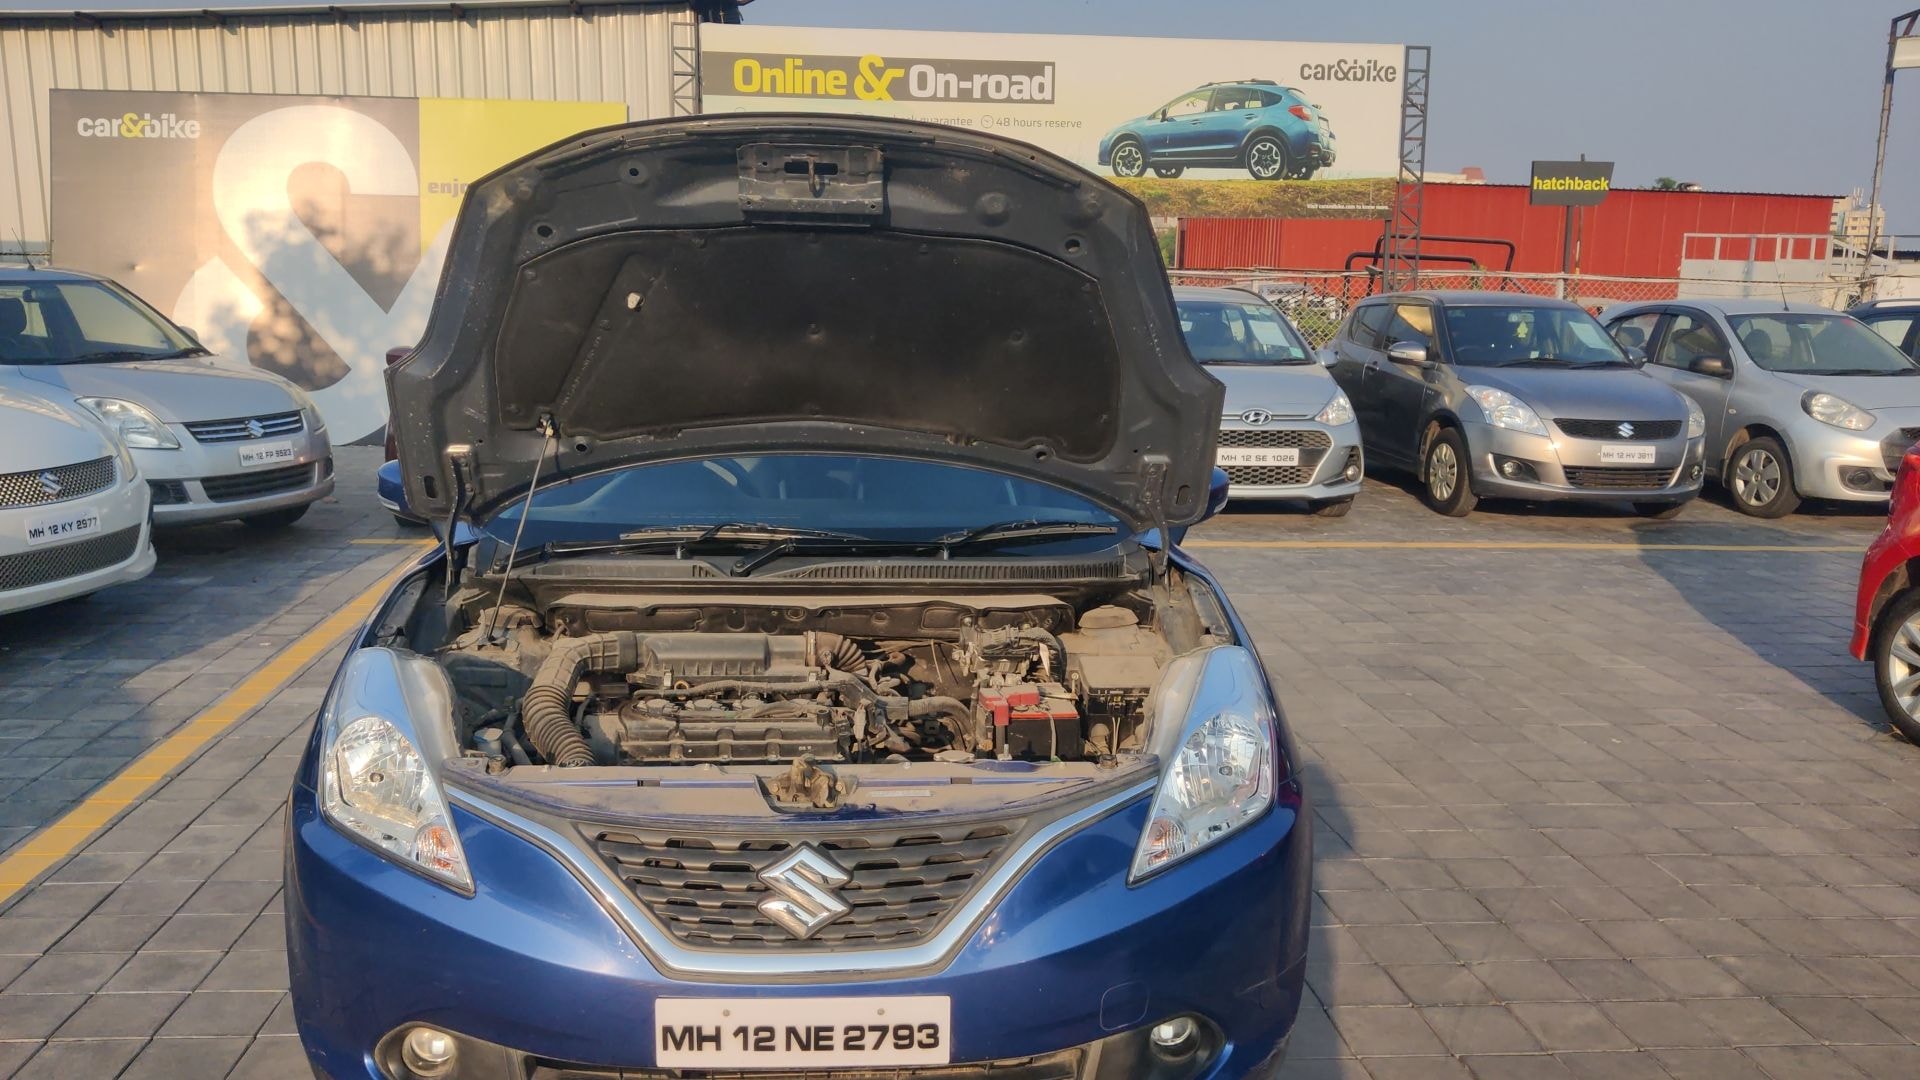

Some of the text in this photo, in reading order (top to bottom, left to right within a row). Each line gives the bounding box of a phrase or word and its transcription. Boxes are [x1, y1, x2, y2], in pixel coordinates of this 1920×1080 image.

[733, 53, 1053, 101] Online & On-road
[1300, 58, 1397, 82] car&bike
[77, 112, 201, 139] car&bike
[919, 116, 973, 127] uarantee
[996, 117, 1011, 127] 48
[1013, 118, 1042, 128] hours
[1044, 119, 1083, 129] reserve
[1533, 175, 1610, 191] hatchback
[1221, 454, 1295, 462] MH 12 SE 1026
[1602, 451, 1614, 459] MH
[29, 517, 97, 538] MH 12 KY 2977
[661, 1023, 940, 1051] MH 12 NE 2793
